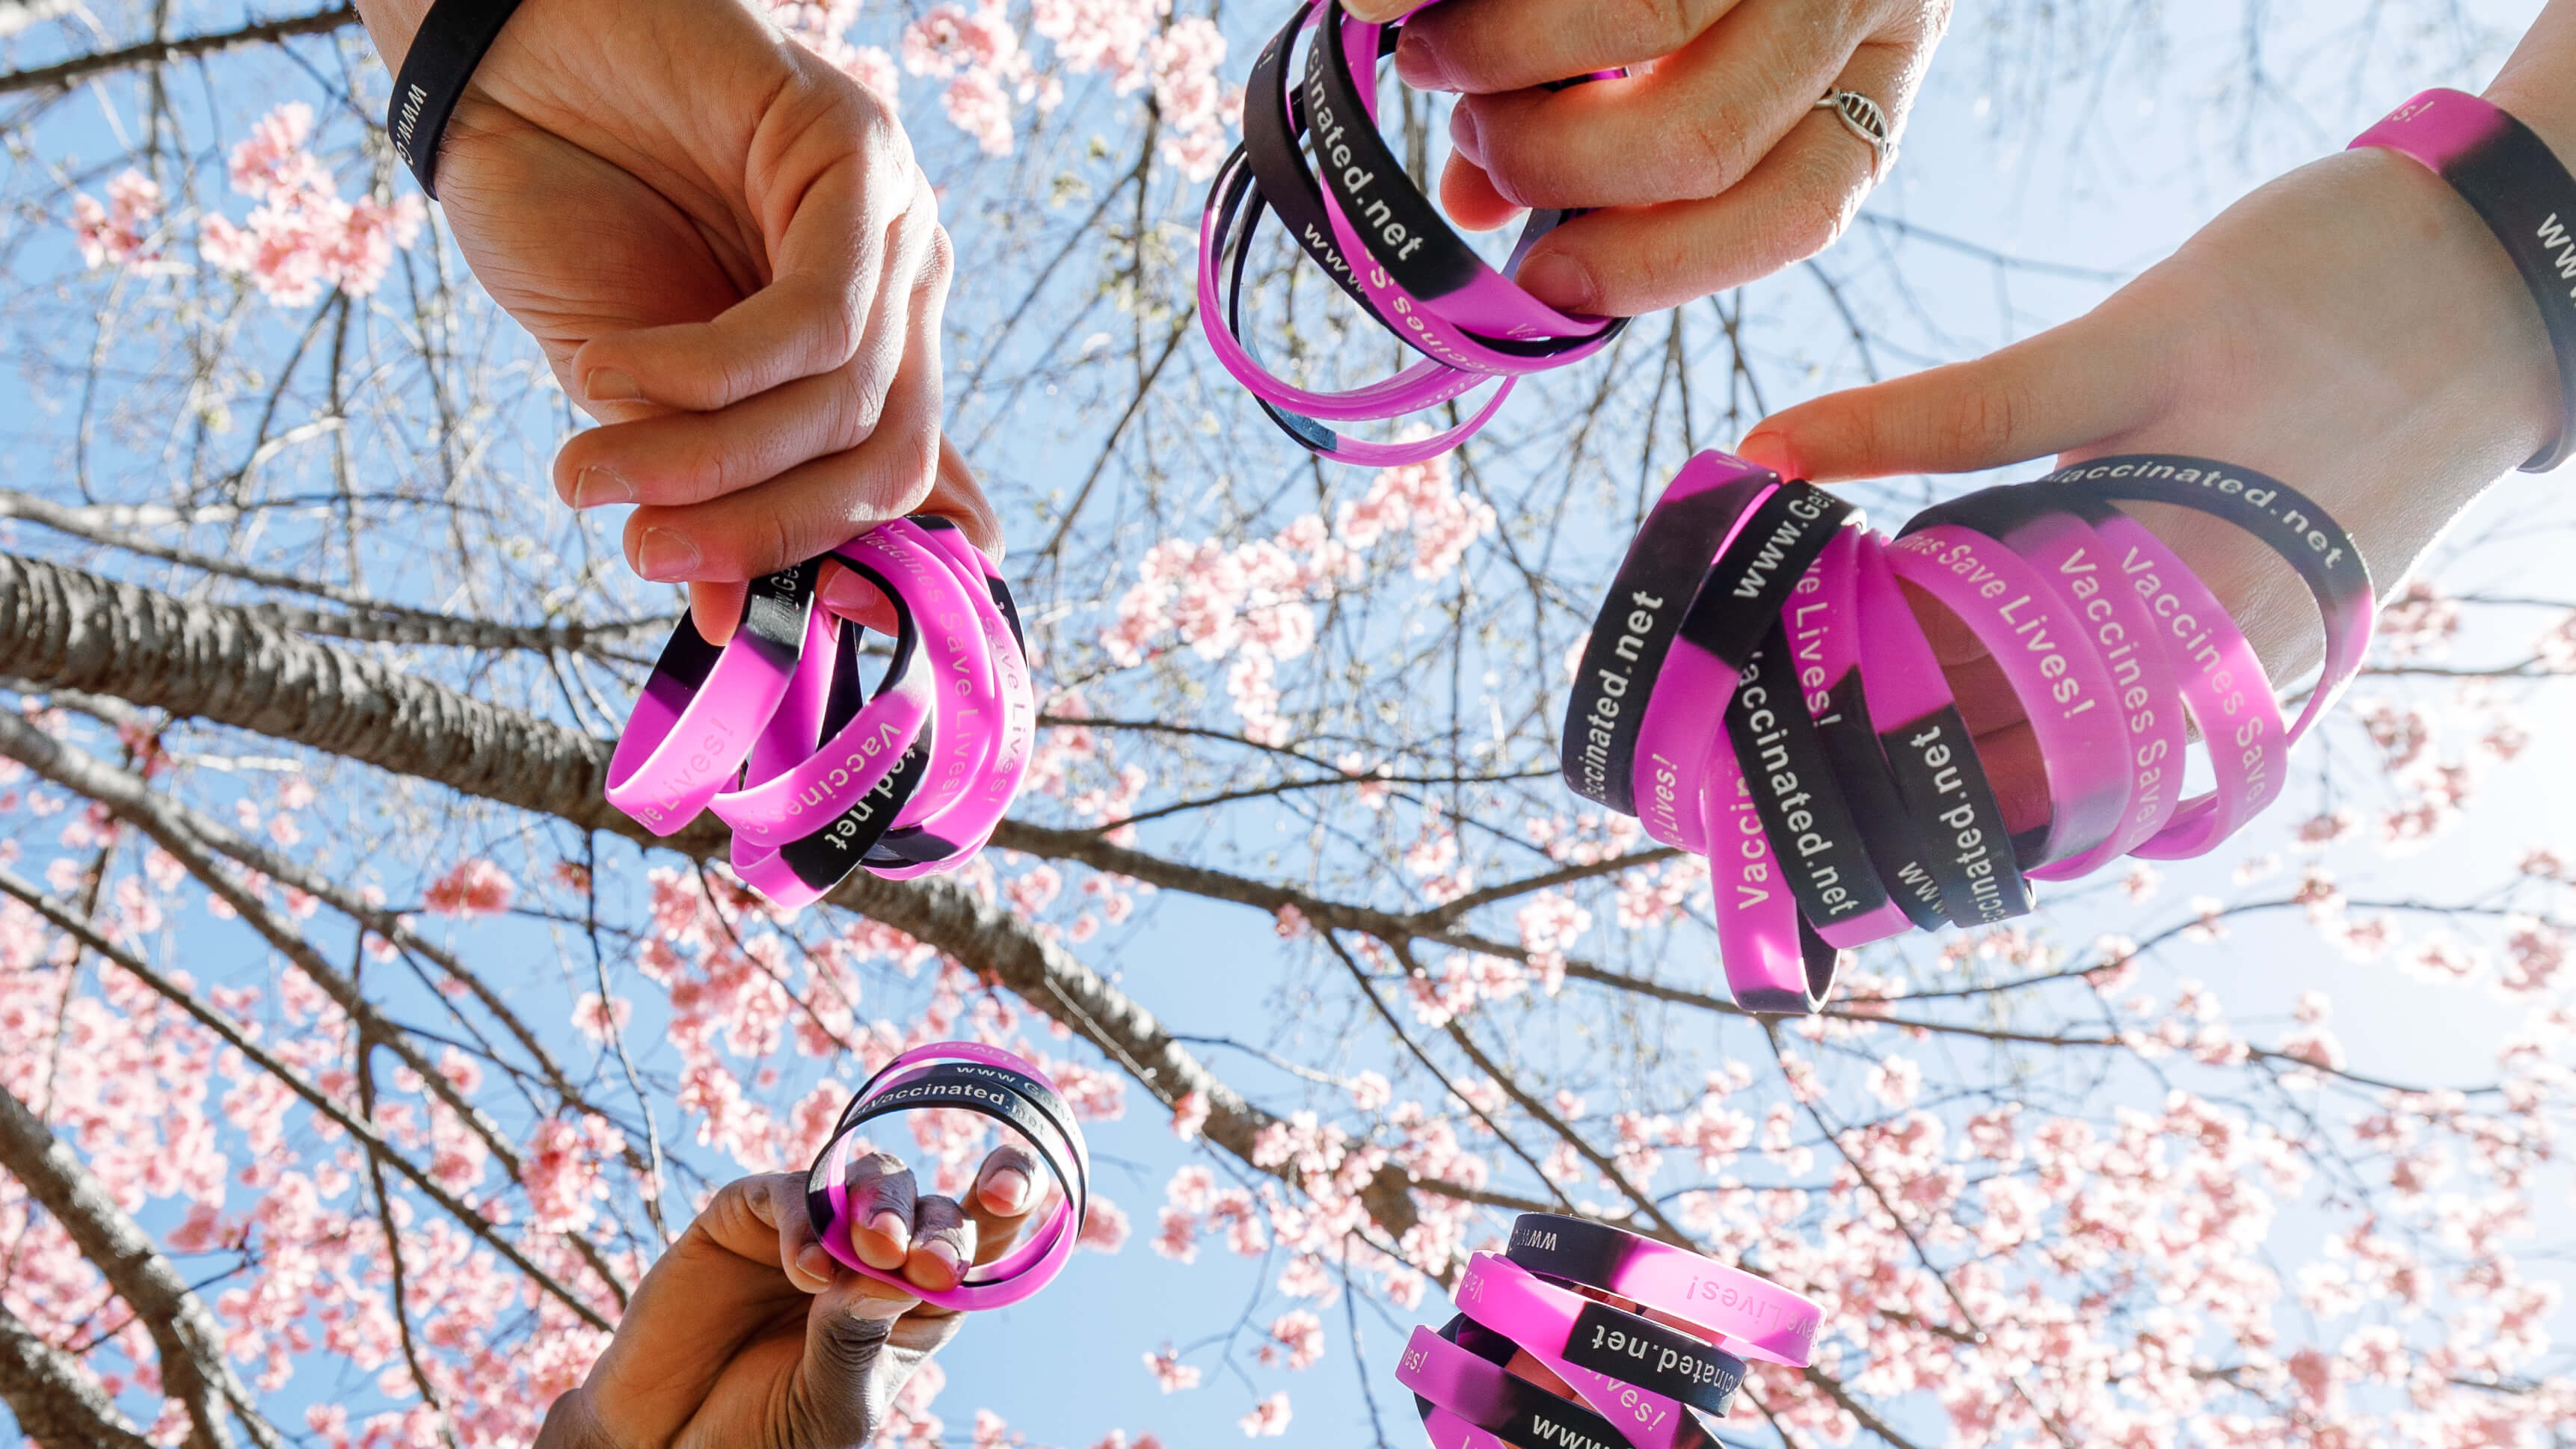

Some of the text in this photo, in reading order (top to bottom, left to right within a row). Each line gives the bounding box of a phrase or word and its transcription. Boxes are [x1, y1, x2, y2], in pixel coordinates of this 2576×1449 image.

[1309, 43, 1422, 260] cinated.net
[2537, 212, 2576, 301] ww
[1394, 297, 1506, 372] ccines
[940, 612, 973, 696] Save
[1797, 602, 1842, 728] Lives!
[1938, 544, 2006, 598] Save
[1999, 595, 2095, 719] Lives!
[2121, 547, 2266, 802] Vaccines Save
[2060, 549, 2154, 734] Vaccines
[2136, 739, 2168, 822] Save
[651, 717, 734, 811] Lives!
[824, 746, 917, 851] ted.net
[937, 708, 979, 799] Lives!
[983, 704, 1026, 804] Lives!
[1650, 753, 1678, 832] Lives!
[1739, 651, 1860, 915] accinated.net
[1730, 757, 1771, 910] Vaccin
[1686, 1276, 1783, 1332] Lives!
[1595, 1373, 1667, 1432] ves!
